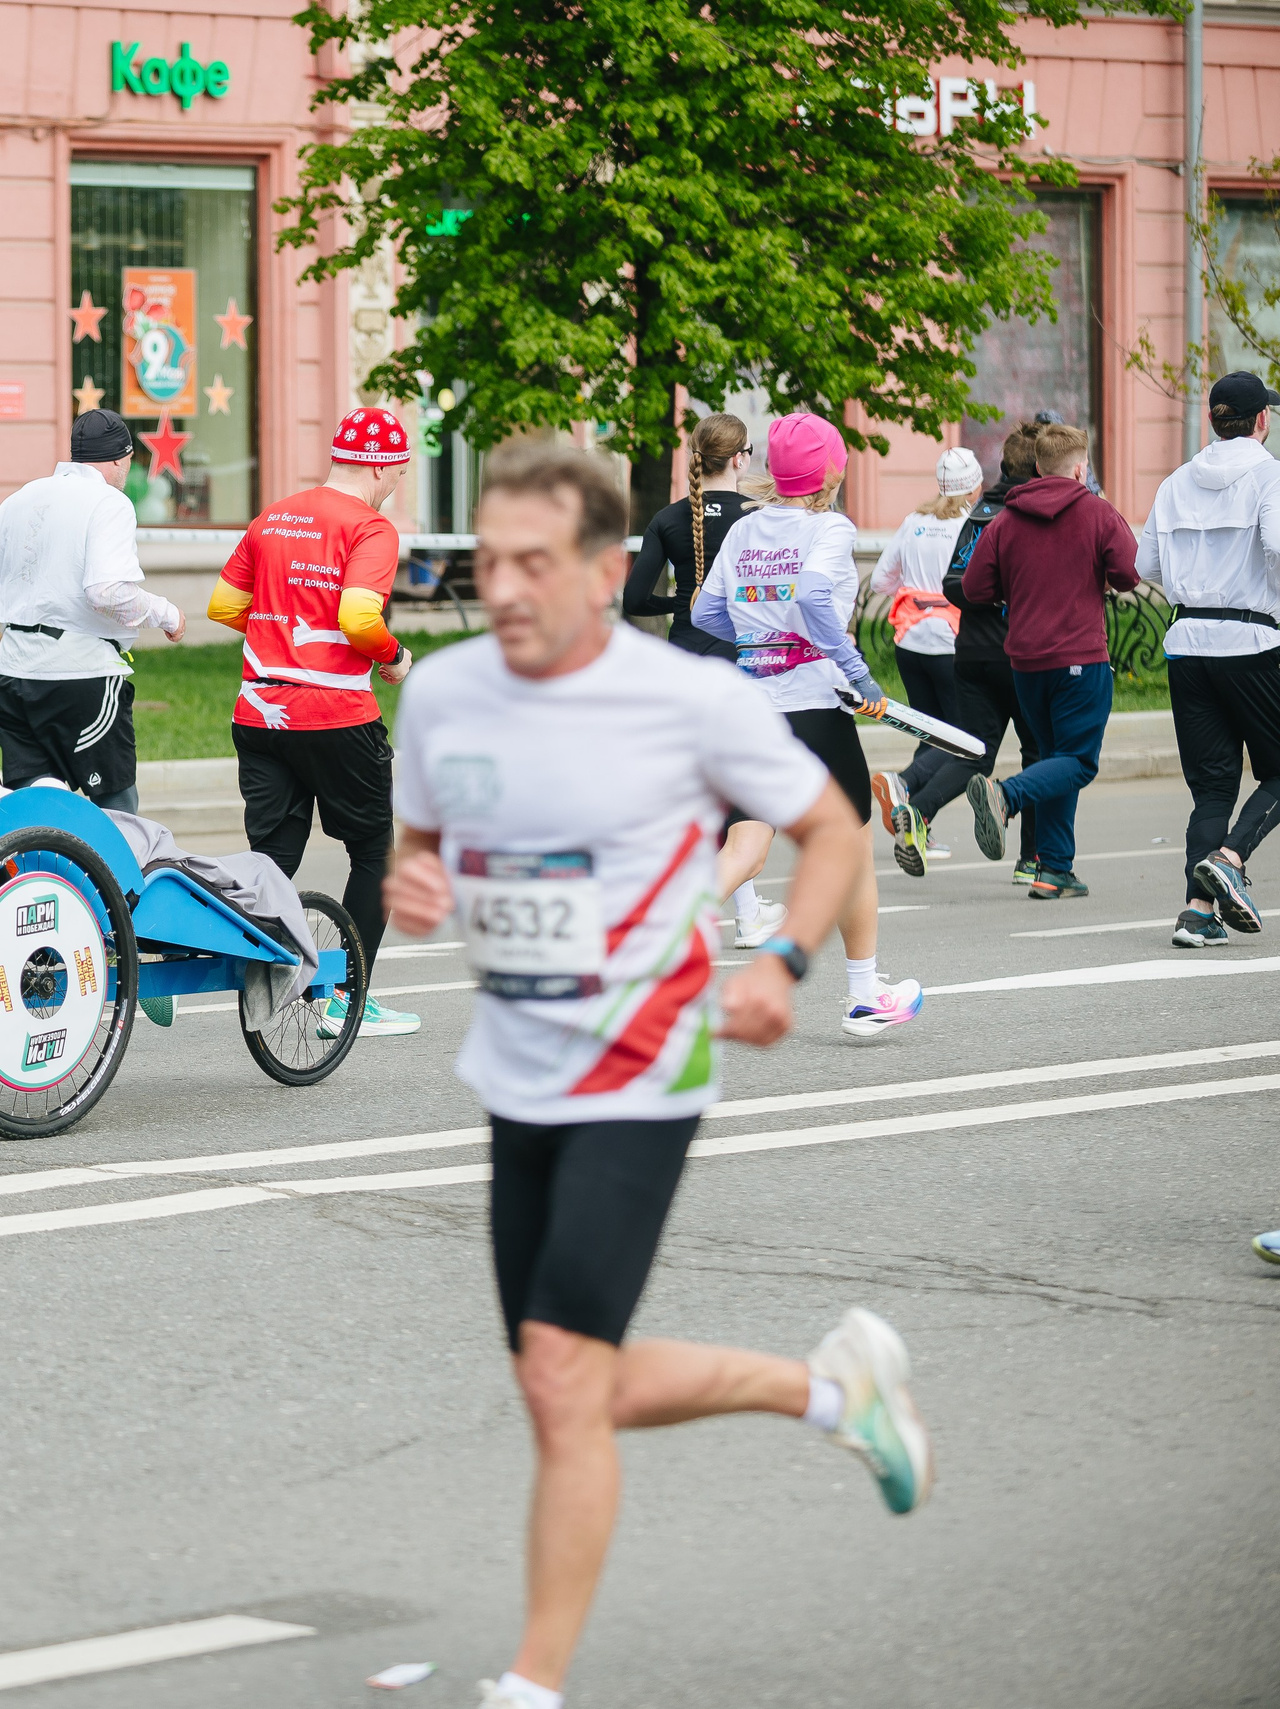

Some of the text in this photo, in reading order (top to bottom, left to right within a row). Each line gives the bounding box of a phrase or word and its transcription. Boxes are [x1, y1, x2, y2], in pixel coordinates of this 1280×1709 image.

[111, 41, 230, 109] Кафе
[141, 329, 169, 381] 9
[267, 512, 314, 525] Без бегунов
[262, 527, 322, 540] нет марафонов
[290, 560, 341, 577] Без людей
[737, 548, 799, 565] ДВИГАЙСЯ
[287, 576, 303, 585] нет
[17, 901, 55, 927] ПАРИ
[22, 919, 55, 935] ПОБЕЖДАЙ
[471, 895, 577, 940] 4532
[73, 950, 87, 996] МОЖЕШЬ
[356, 941, 367, 990] CONTINENTAL
[26, 1039, 65, 1065] ПАРИ
[66, 1027, 122, 1106] FELGEBIETER
